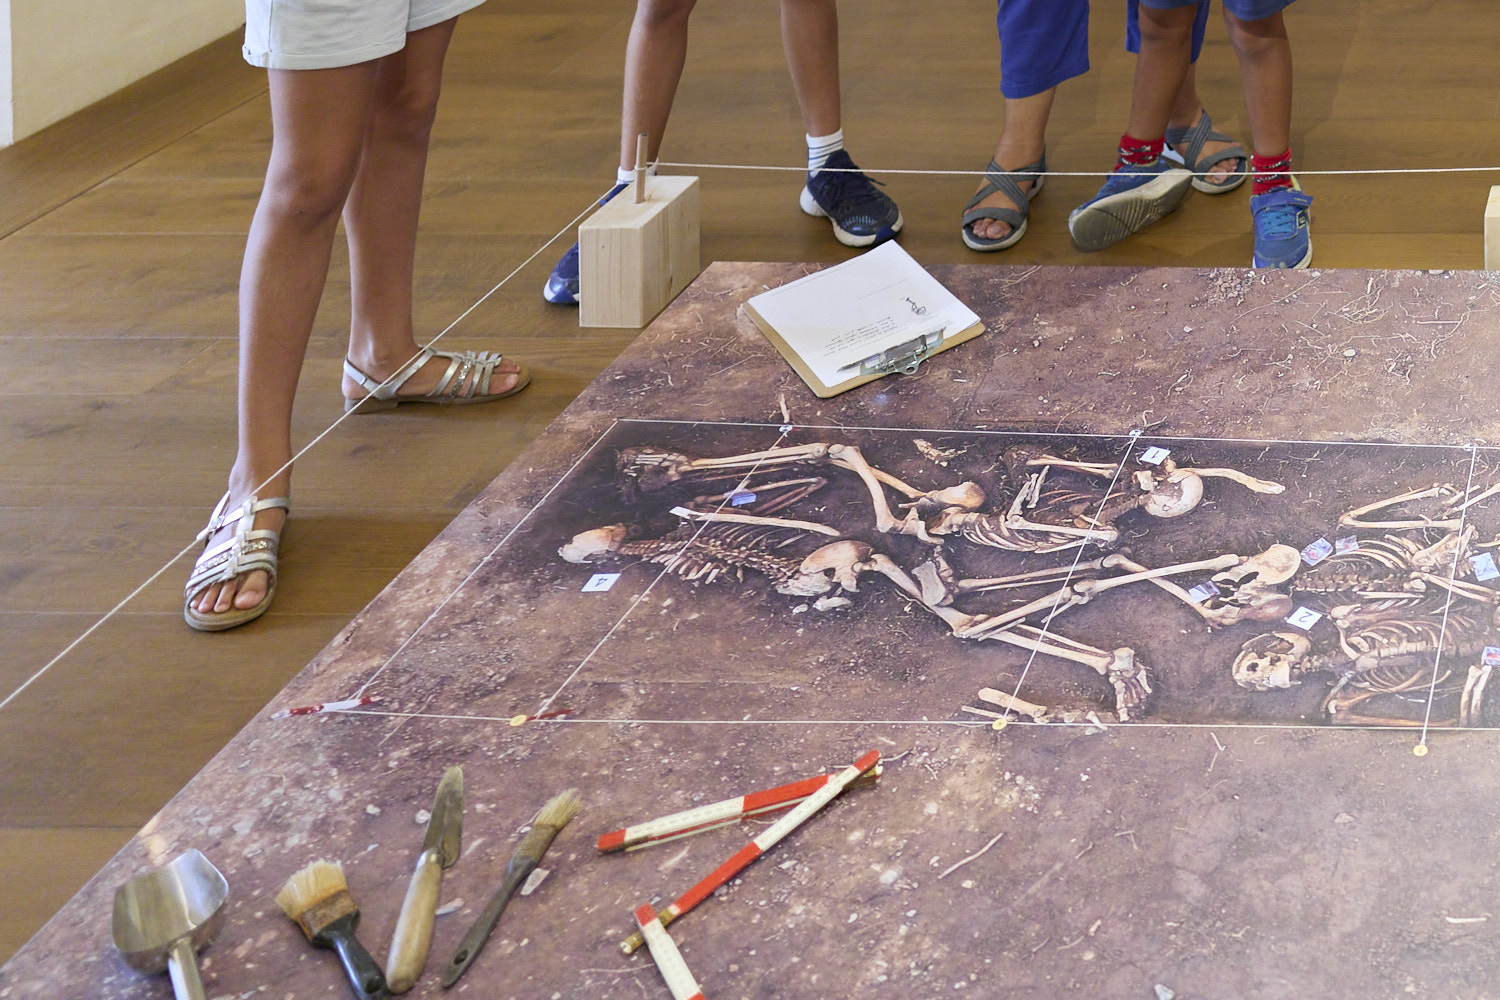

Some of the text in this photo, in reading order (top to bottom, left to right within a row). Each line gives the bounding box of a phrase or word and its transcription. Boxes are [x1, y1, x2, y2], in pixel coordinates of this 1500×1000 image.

[1151, 450, 1159, 459] 1
[596, 577, 609, 588] 4
[1298, 612, 1314, 623] 2
